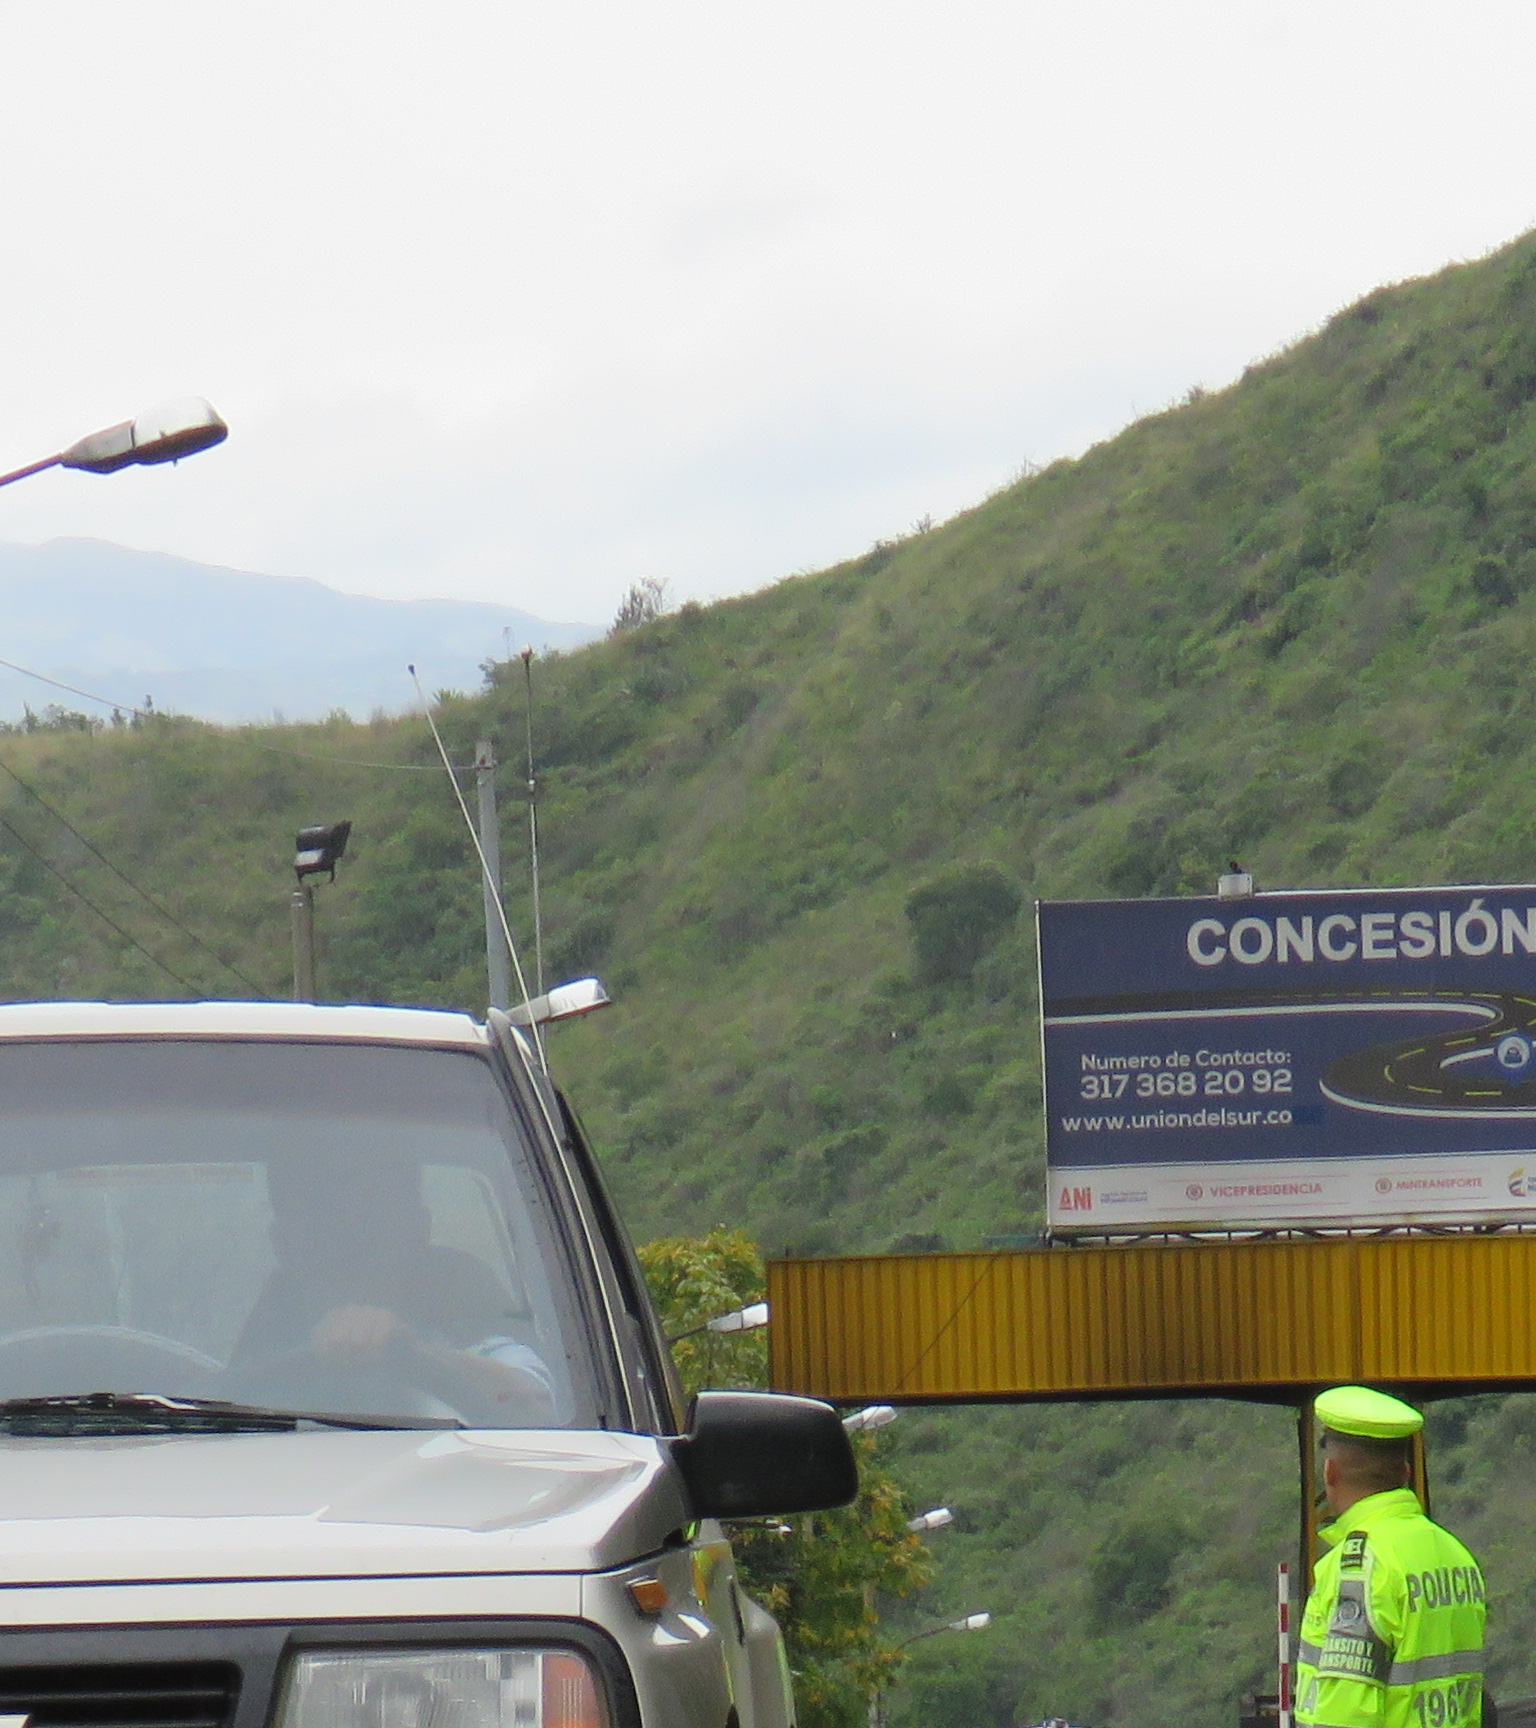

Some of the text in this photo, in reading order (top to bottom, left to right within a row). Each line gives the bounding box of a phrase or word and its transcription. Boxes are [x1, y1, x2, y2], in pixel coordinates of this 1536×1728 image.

[1080, 1048, 1292, 1071] Numero de Contacto:
[1080, 1068, 1293, 1100] 317 368 20 92
[1062, 1107, 1293, 1132] www.uniondelsur.co
[1209, 1182, 1324, 1199] VICEPRESIDENCIA
[1395, 1177, 1483, 1191] MINTRANSPORTE
